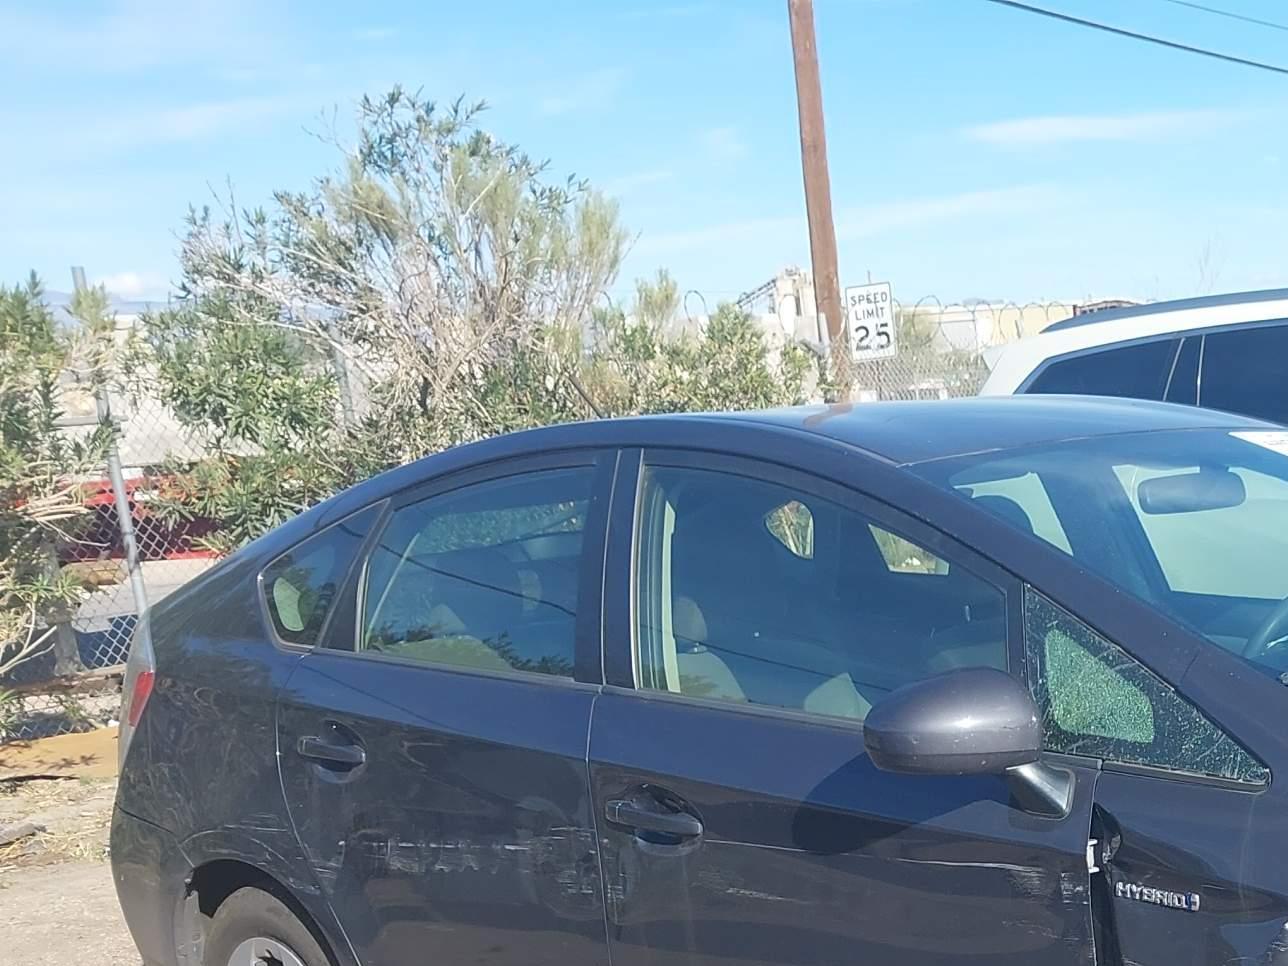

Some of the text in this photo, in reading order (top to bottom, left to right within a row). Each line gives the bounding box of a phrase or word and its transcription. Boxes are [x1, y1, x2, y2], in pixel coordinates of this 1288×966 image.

[850, 292, 888, 307] SPEED
[855, 307, 886, 321] LIMIT
[855, 322, 892, 352] 25
[1115, 881, 1185, 909] HYBRID
